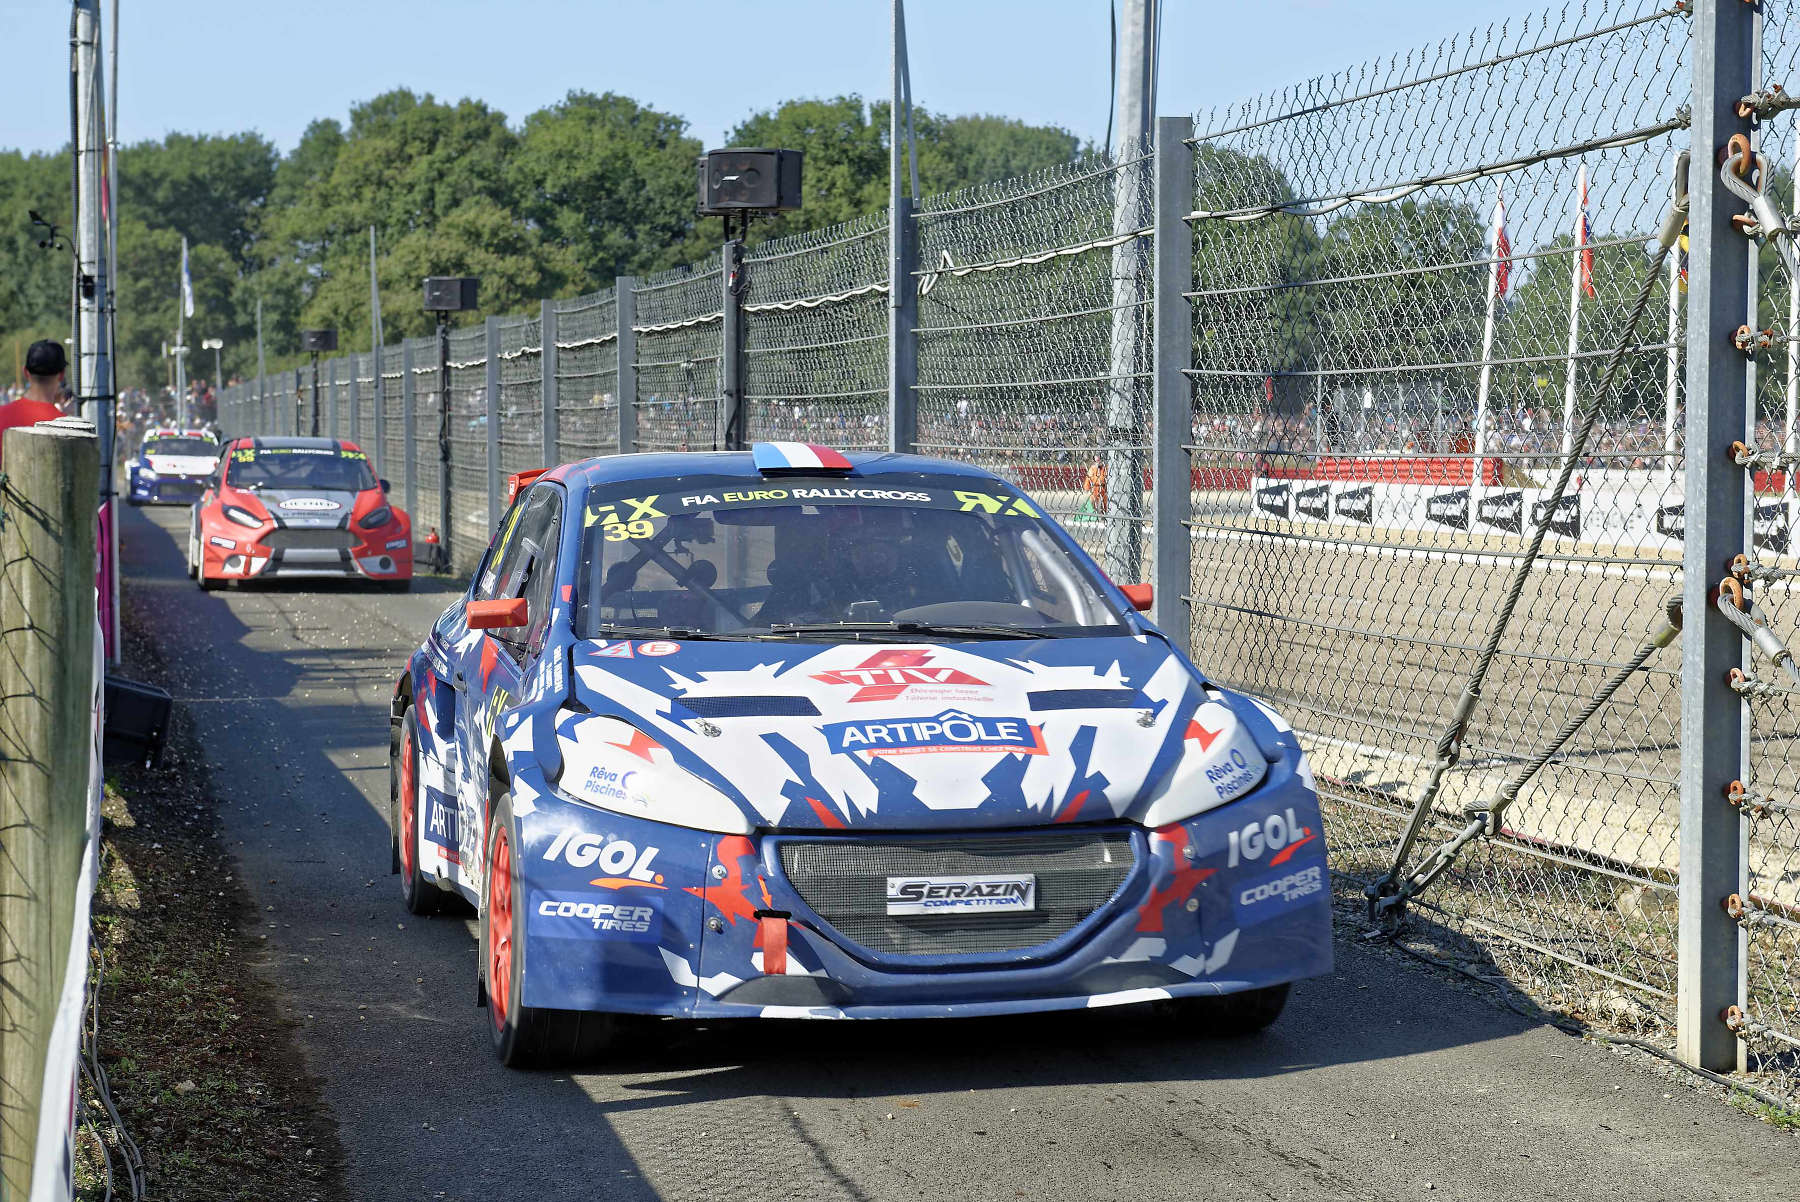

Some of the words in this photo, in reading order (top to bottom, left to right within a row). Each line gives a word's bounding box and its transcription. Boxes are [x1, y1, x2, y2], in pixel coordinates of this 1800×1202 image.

[681, 494, 720, 507] FIA
[723, 489, 788, 503] EURO
[792, 488, 931, 502] RALLYCROSS
[604, 519, 655, 542] 39
[841, 711, 1024, 749] ARTIPÔLE
[589, 766, 618, 782] Rêva
[584, 780, 627, 800] Piscines
[898, 882, 1032, 905] SERAZIN
[1240, 866, 1321, 906] COOPER
[1282, 880, 1323, 902] TIRES
[538, 900, 654, 922] COOPER
[923, 897, 1018, 908] COMPETITION
[591, 918, 650, 932] TIRES
